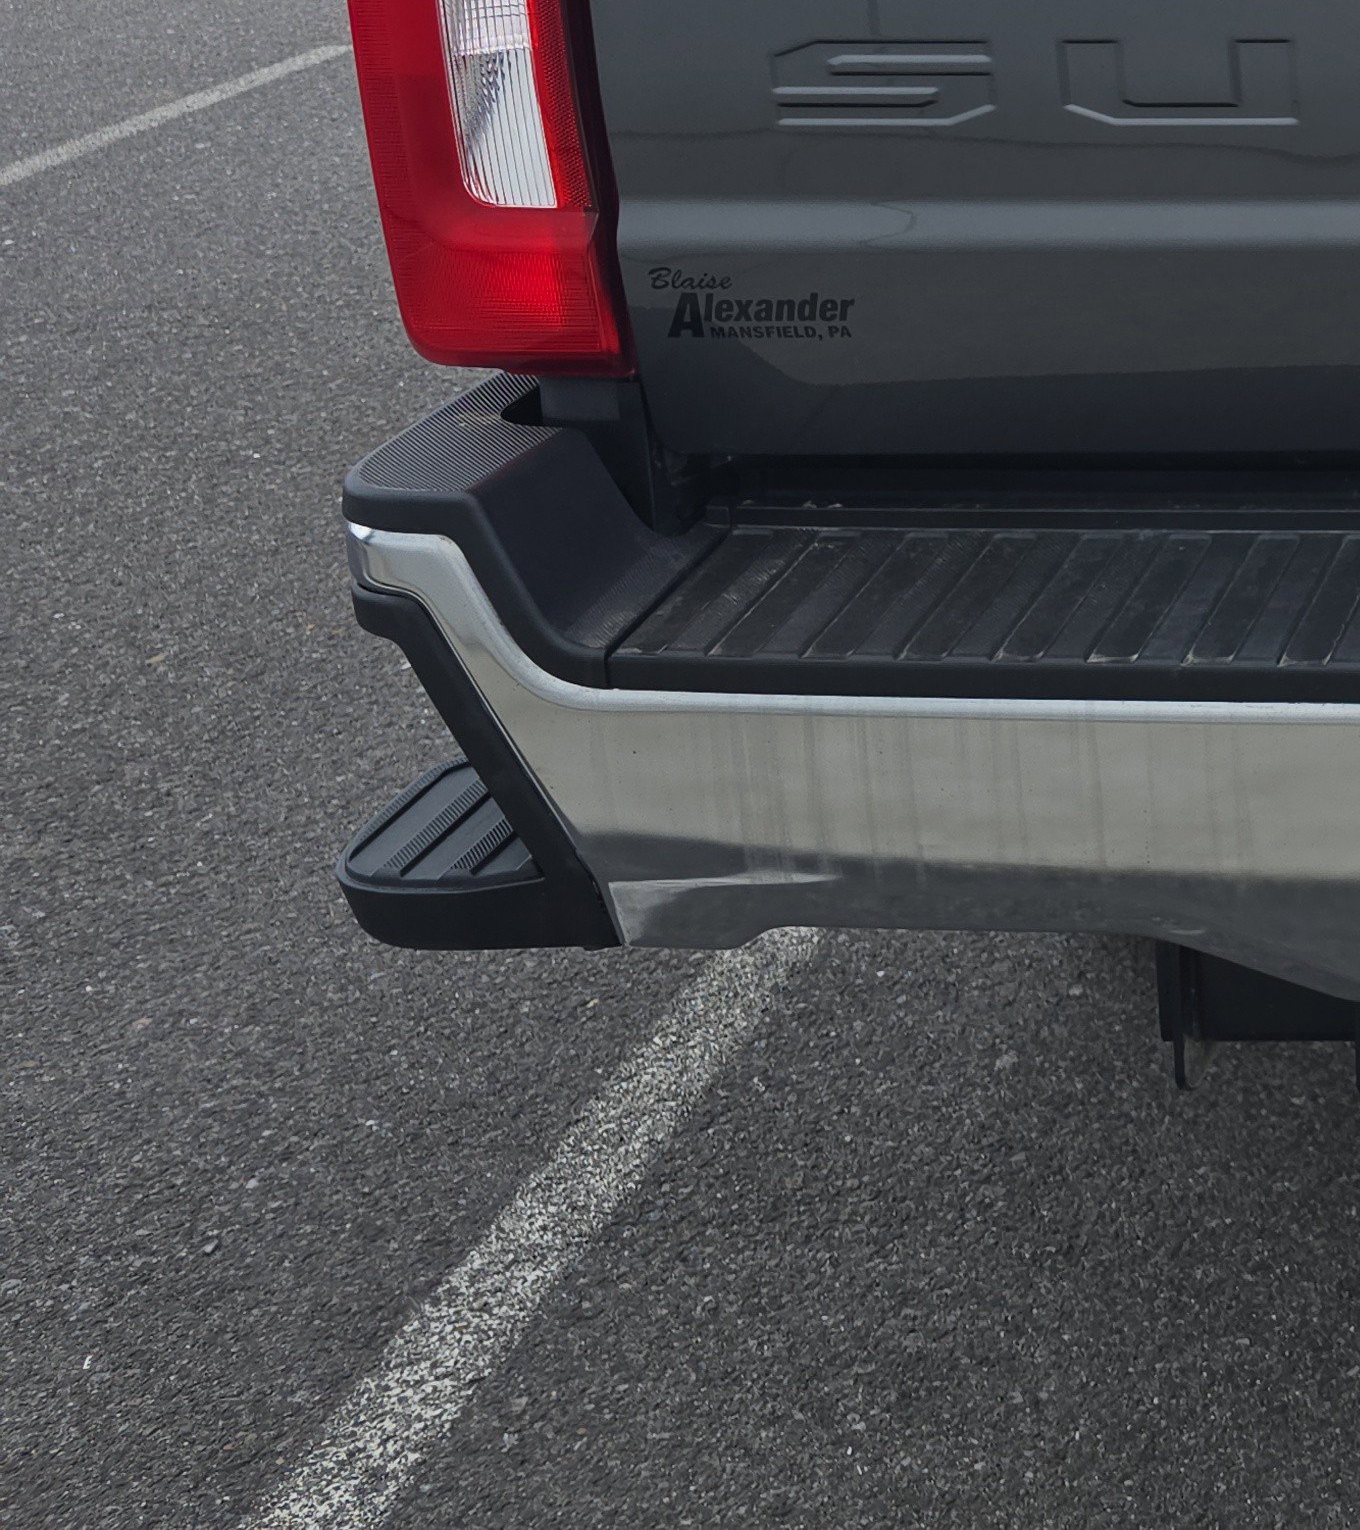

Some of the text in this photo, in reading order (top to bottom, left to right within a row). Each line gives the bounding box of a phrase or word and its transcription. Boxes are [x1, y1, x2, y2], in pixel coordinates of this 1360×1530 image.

[648, 267, 733, 290] Blaise
[667, 292, 855, 338] Alexander
[709, 325, 852, 341] MANSFIELD, PA
